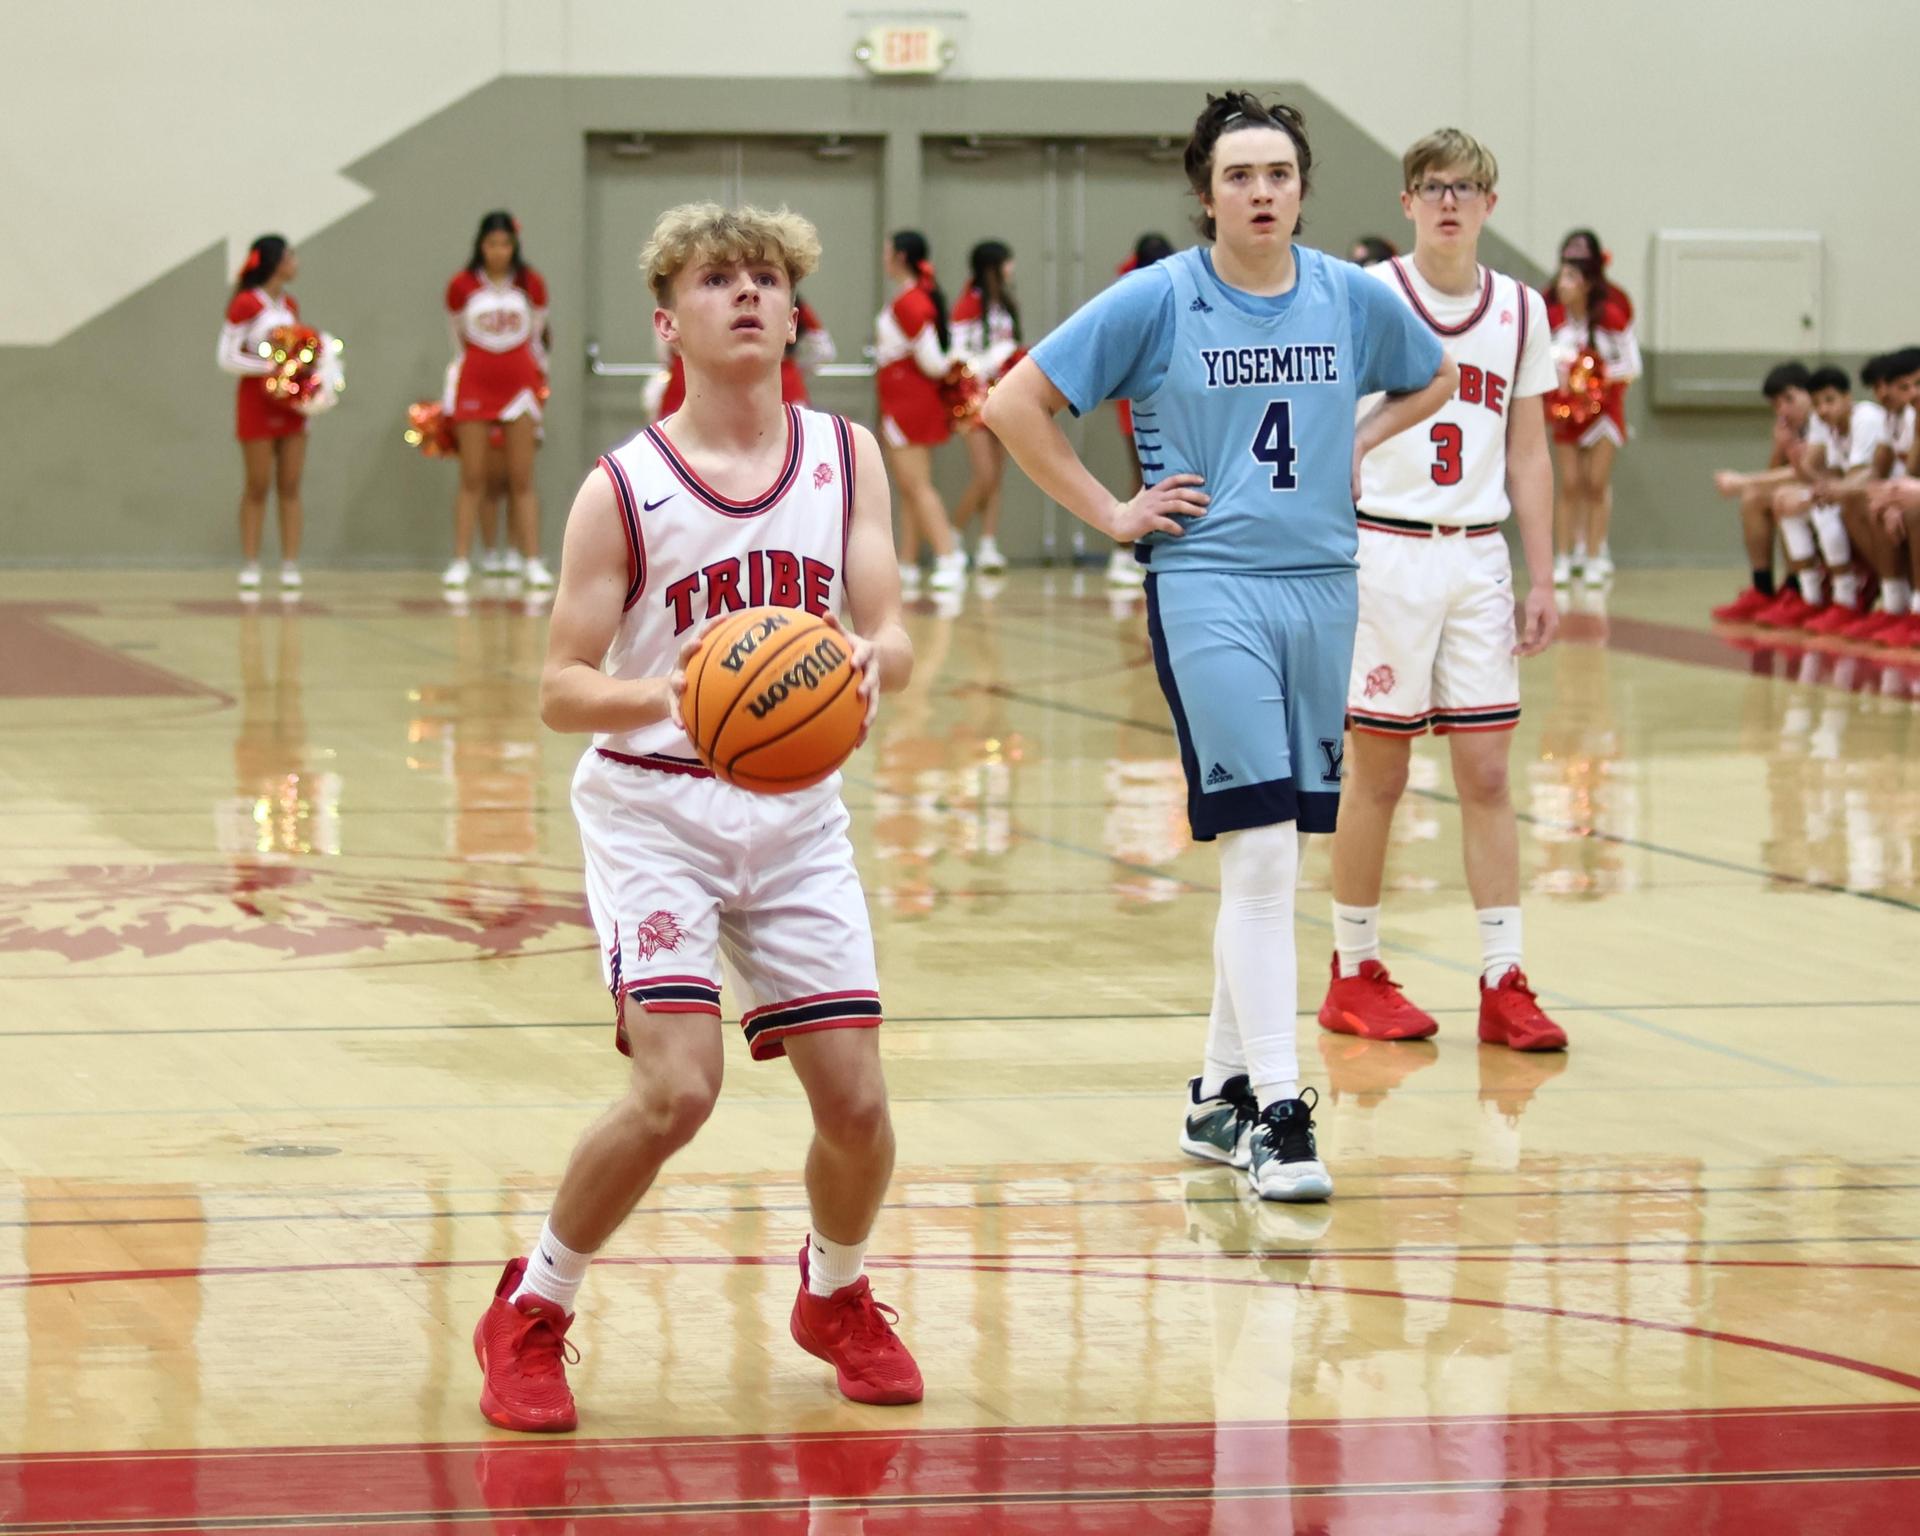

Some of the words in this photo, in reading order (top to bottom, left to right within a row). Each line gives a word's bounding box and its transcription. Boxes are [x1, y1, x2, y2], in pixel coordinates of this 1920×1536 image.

[1202, 346, 1338, 387] YOSEMITE
[1251, 400, 1297, 491] 4
[1430, 422, 1463, 486] 3
[665, 550, 835, 637] TRIBE
[720, 613, 792, 672] NCAA
[747, 636, 847, 720] Wilson
[1319, 738, 1344, 784] Y
